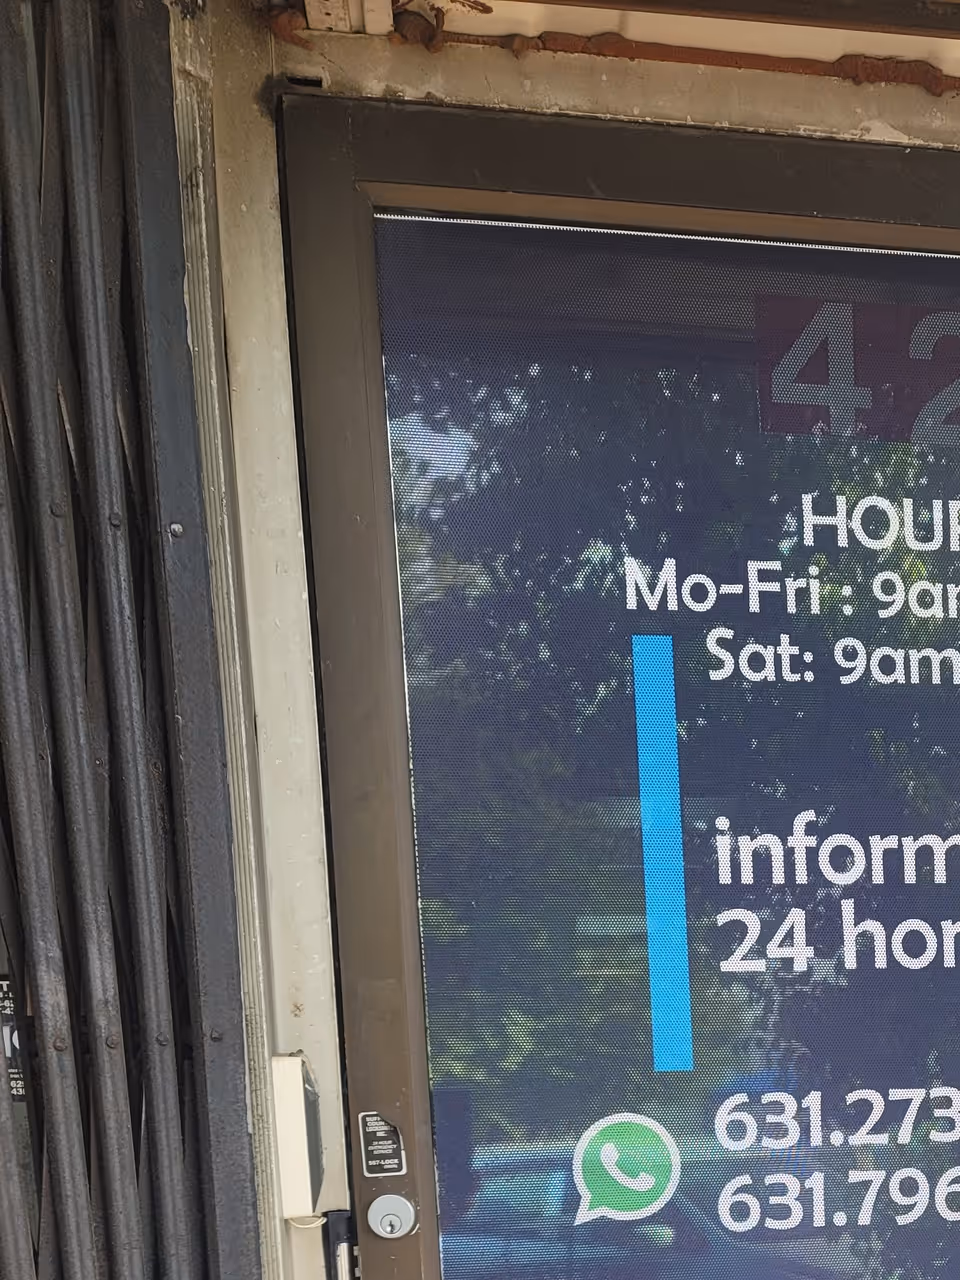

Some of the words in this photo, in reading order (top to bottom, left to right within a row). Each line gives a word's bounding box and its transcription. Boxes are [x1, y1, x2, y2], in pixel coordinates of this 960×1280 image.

[624, 556, 820, 615] Mo-Fri
[704, 626, 815, 683] Sat:
[715, 908, 814, 973] 24
